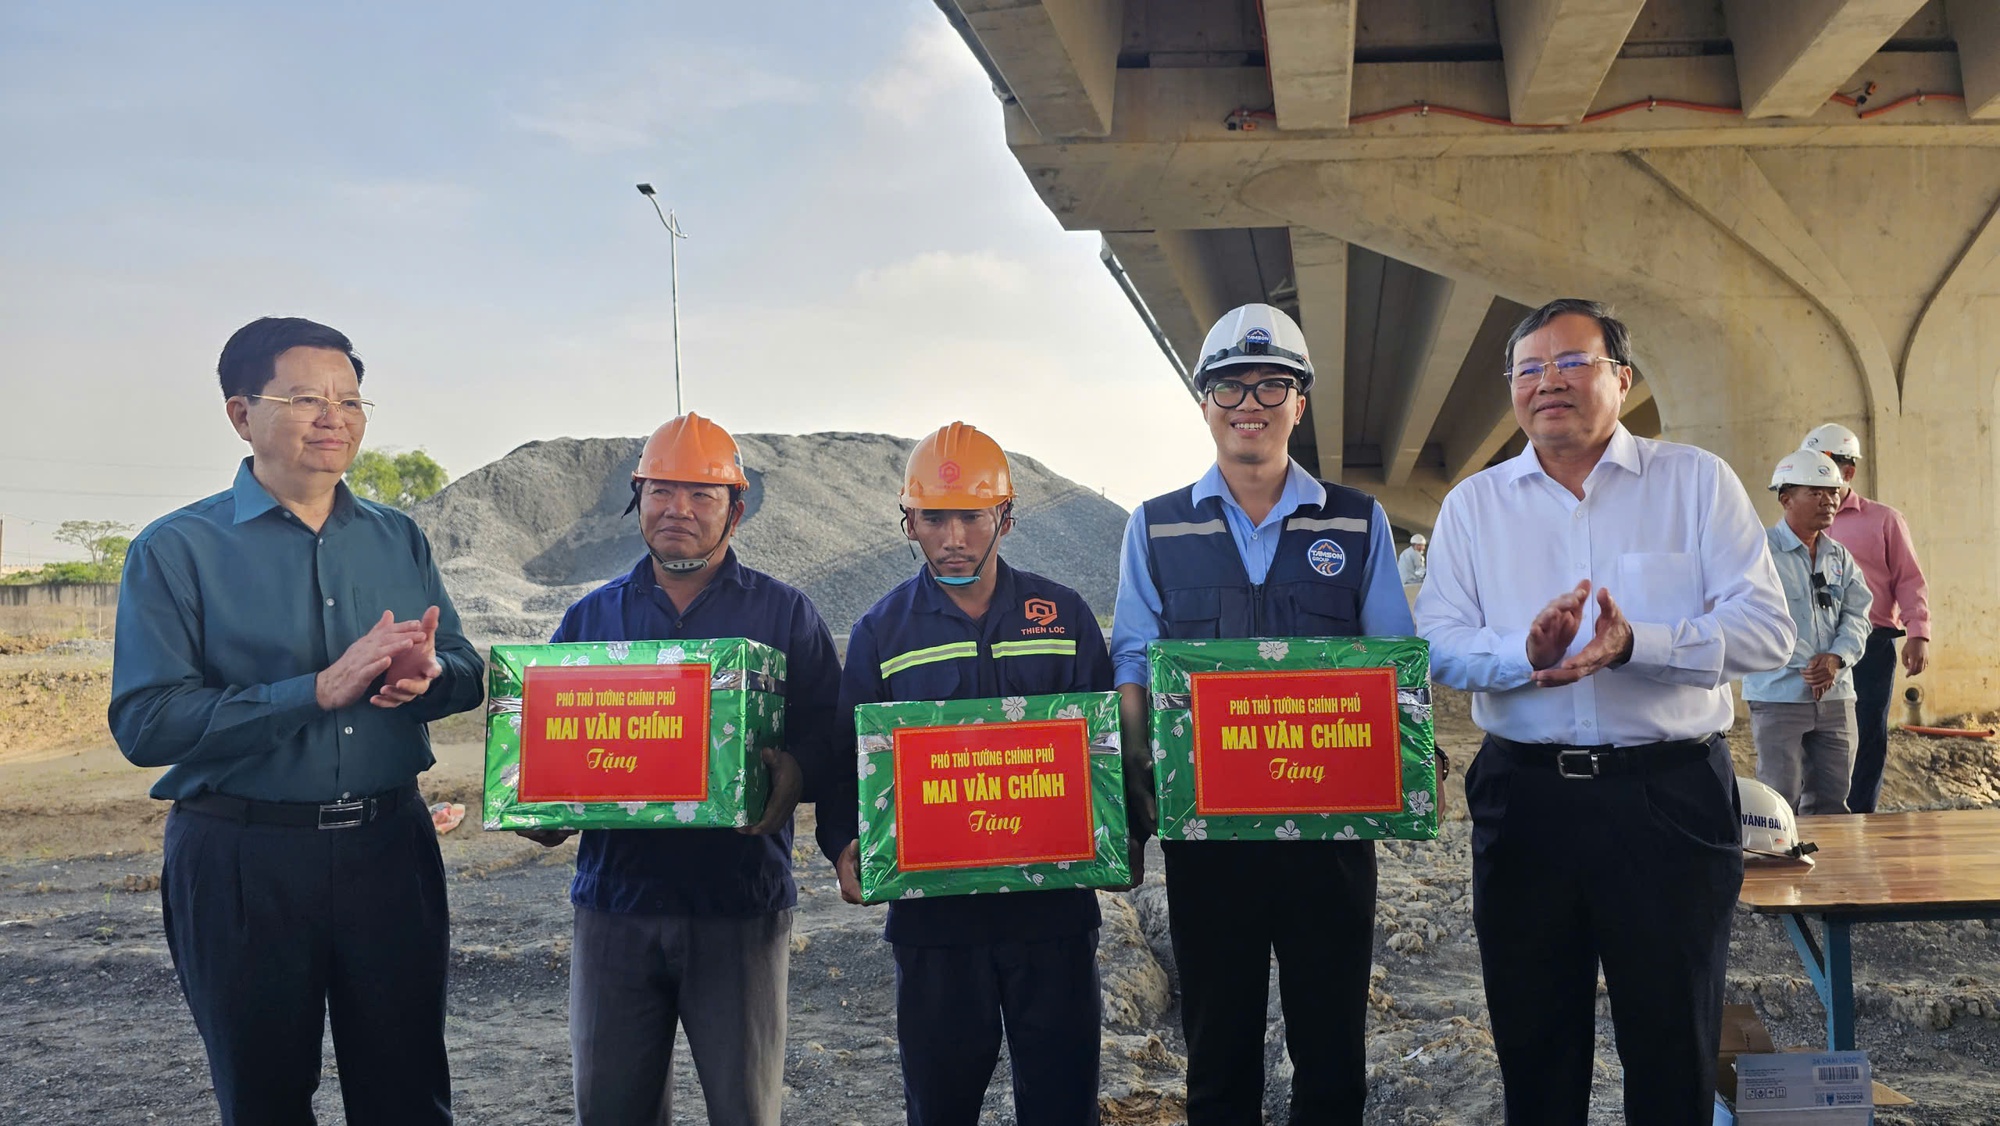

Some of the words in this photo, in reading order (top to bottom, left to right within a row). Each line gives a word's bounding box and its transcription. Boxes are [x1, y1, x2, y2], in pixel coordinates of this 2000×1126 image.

[556, 689, 574, 707] PHÓ
[577, 687, 594, 706] THỦ
[596, 689, 625, 706] TƯỚNG
[627, 688, 655, 706] CHÍNH
[657, 686, 676, 706] PHỦ
[1230, 697, 1250, 715] PHÓ
[1252, 694, 1271, 715] THỦ
[1273, 696, 1305, 714] TƯỚNG
[1308, 695, 1338, 713] CHÍNH
[1340, 692, 1361, 713] PHỦ
[546, 717, 579, 740] MAI
[585, 712, 621, 740] VĂN
[627, 711, 683, 739] CHÍNH
[1221, 726, 1257, 750] MAI
[1263, 720, 1304, 749] VĂN
[1311, 718, 1372, 748] CHÍNH
[586, 748, 638, 774] Tặng
[931, 751, 950, 769] PHÓ
[952, 747, 970, 768] THỦ
[972, 748, 1003, 767] TƯỚNG
[1004, 746, 1034, 765] CHÍNH
[1035, 743, 1055, 763] PHỦ
[1269, 758, 1326, 784] Tặng
[922, 779, 957, 804] MAI
[963, 772, 1002, 802] VĂN
[1008, 768, 1065, 799] CHÍNH
[968, 810, 1023, 835] Tặng
[1741, 812, 1767, 828] VÀNH
